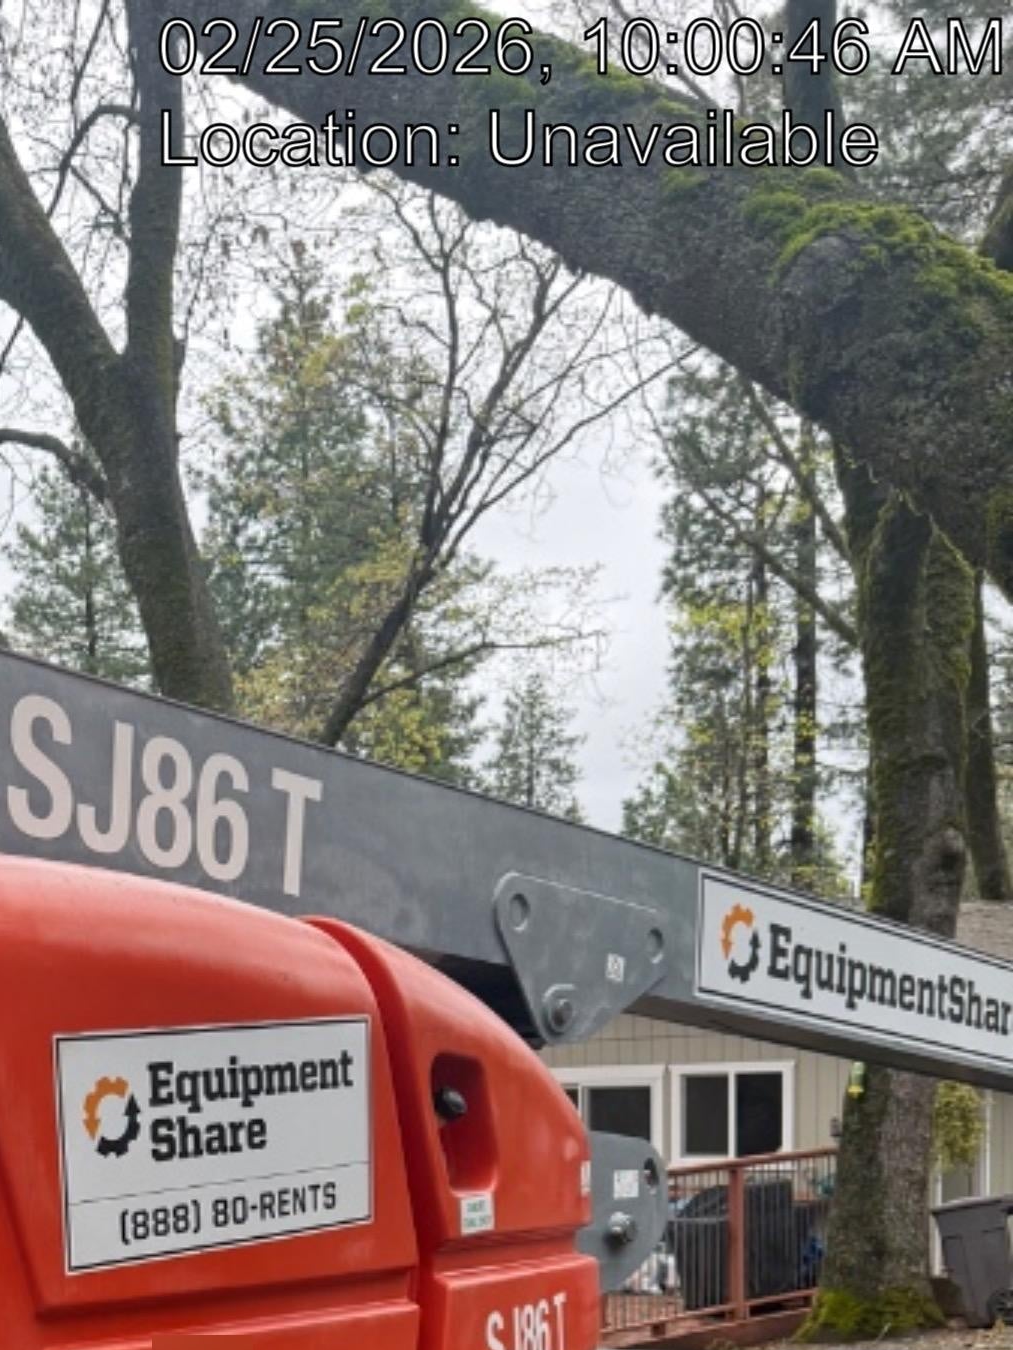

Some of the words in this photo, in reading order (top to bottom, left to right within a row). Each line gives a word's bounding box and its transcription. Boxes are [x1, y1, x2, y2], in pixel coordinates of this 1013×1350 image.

[7, 694, 250, 882] SJ86
[271, 768, 324, 897] T
[767, 924, 1013, 1036] EquipmentShar
[148, 1050, 353, 1113] Equipment
[150, 1115, 266, 1161] Share
[120, 1199, 201, 1245] (888)
[212, 1182, 336, 1228] 80-RENTS
